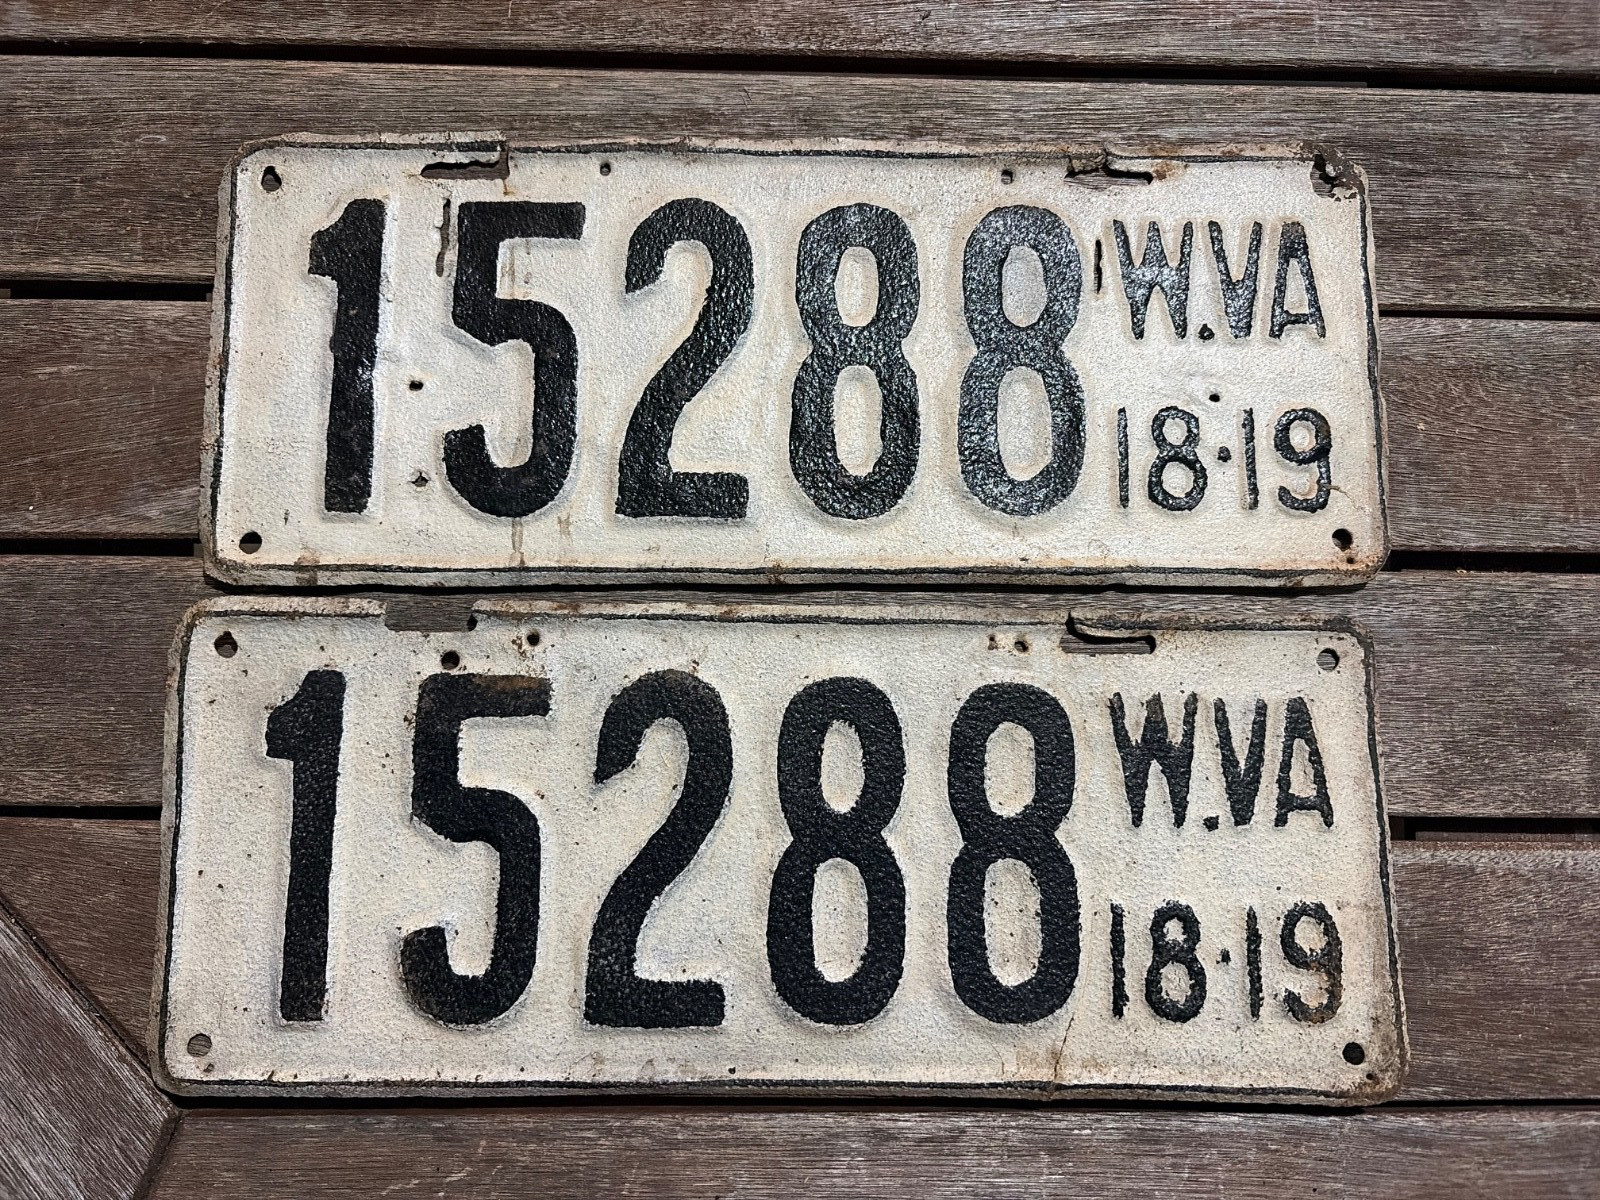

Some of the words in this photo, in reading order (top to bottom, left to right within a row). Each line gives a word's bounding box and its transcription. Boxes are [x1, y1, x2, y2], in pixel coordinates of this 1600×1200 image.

[309, 197, 1086, 519] 15288
[1113, 220, 1326, 342] W.VA
[265, 670, 1081, 1028] 15288
[1110, 691, 1334, 831] W.VA
